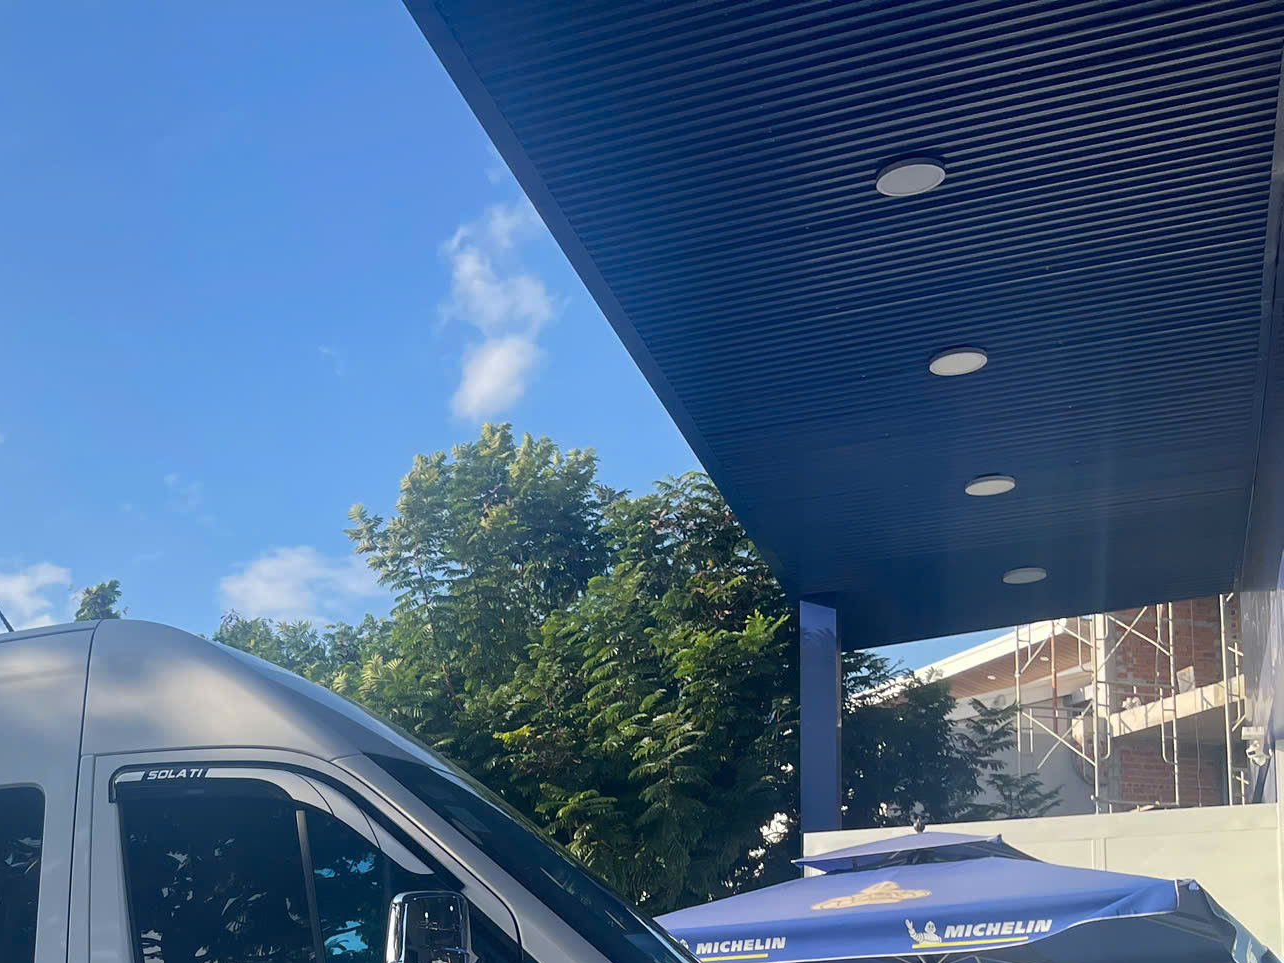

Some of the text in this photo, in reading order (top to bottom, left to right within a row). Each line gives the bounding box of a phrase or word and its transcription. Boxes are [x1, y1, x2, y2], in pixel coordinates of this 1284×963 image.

[147, 768, 203, 780] SOLATI
[944, 919, 1052, 939] MICHELIN
[695, 936, 787, 954] MICHELIN
